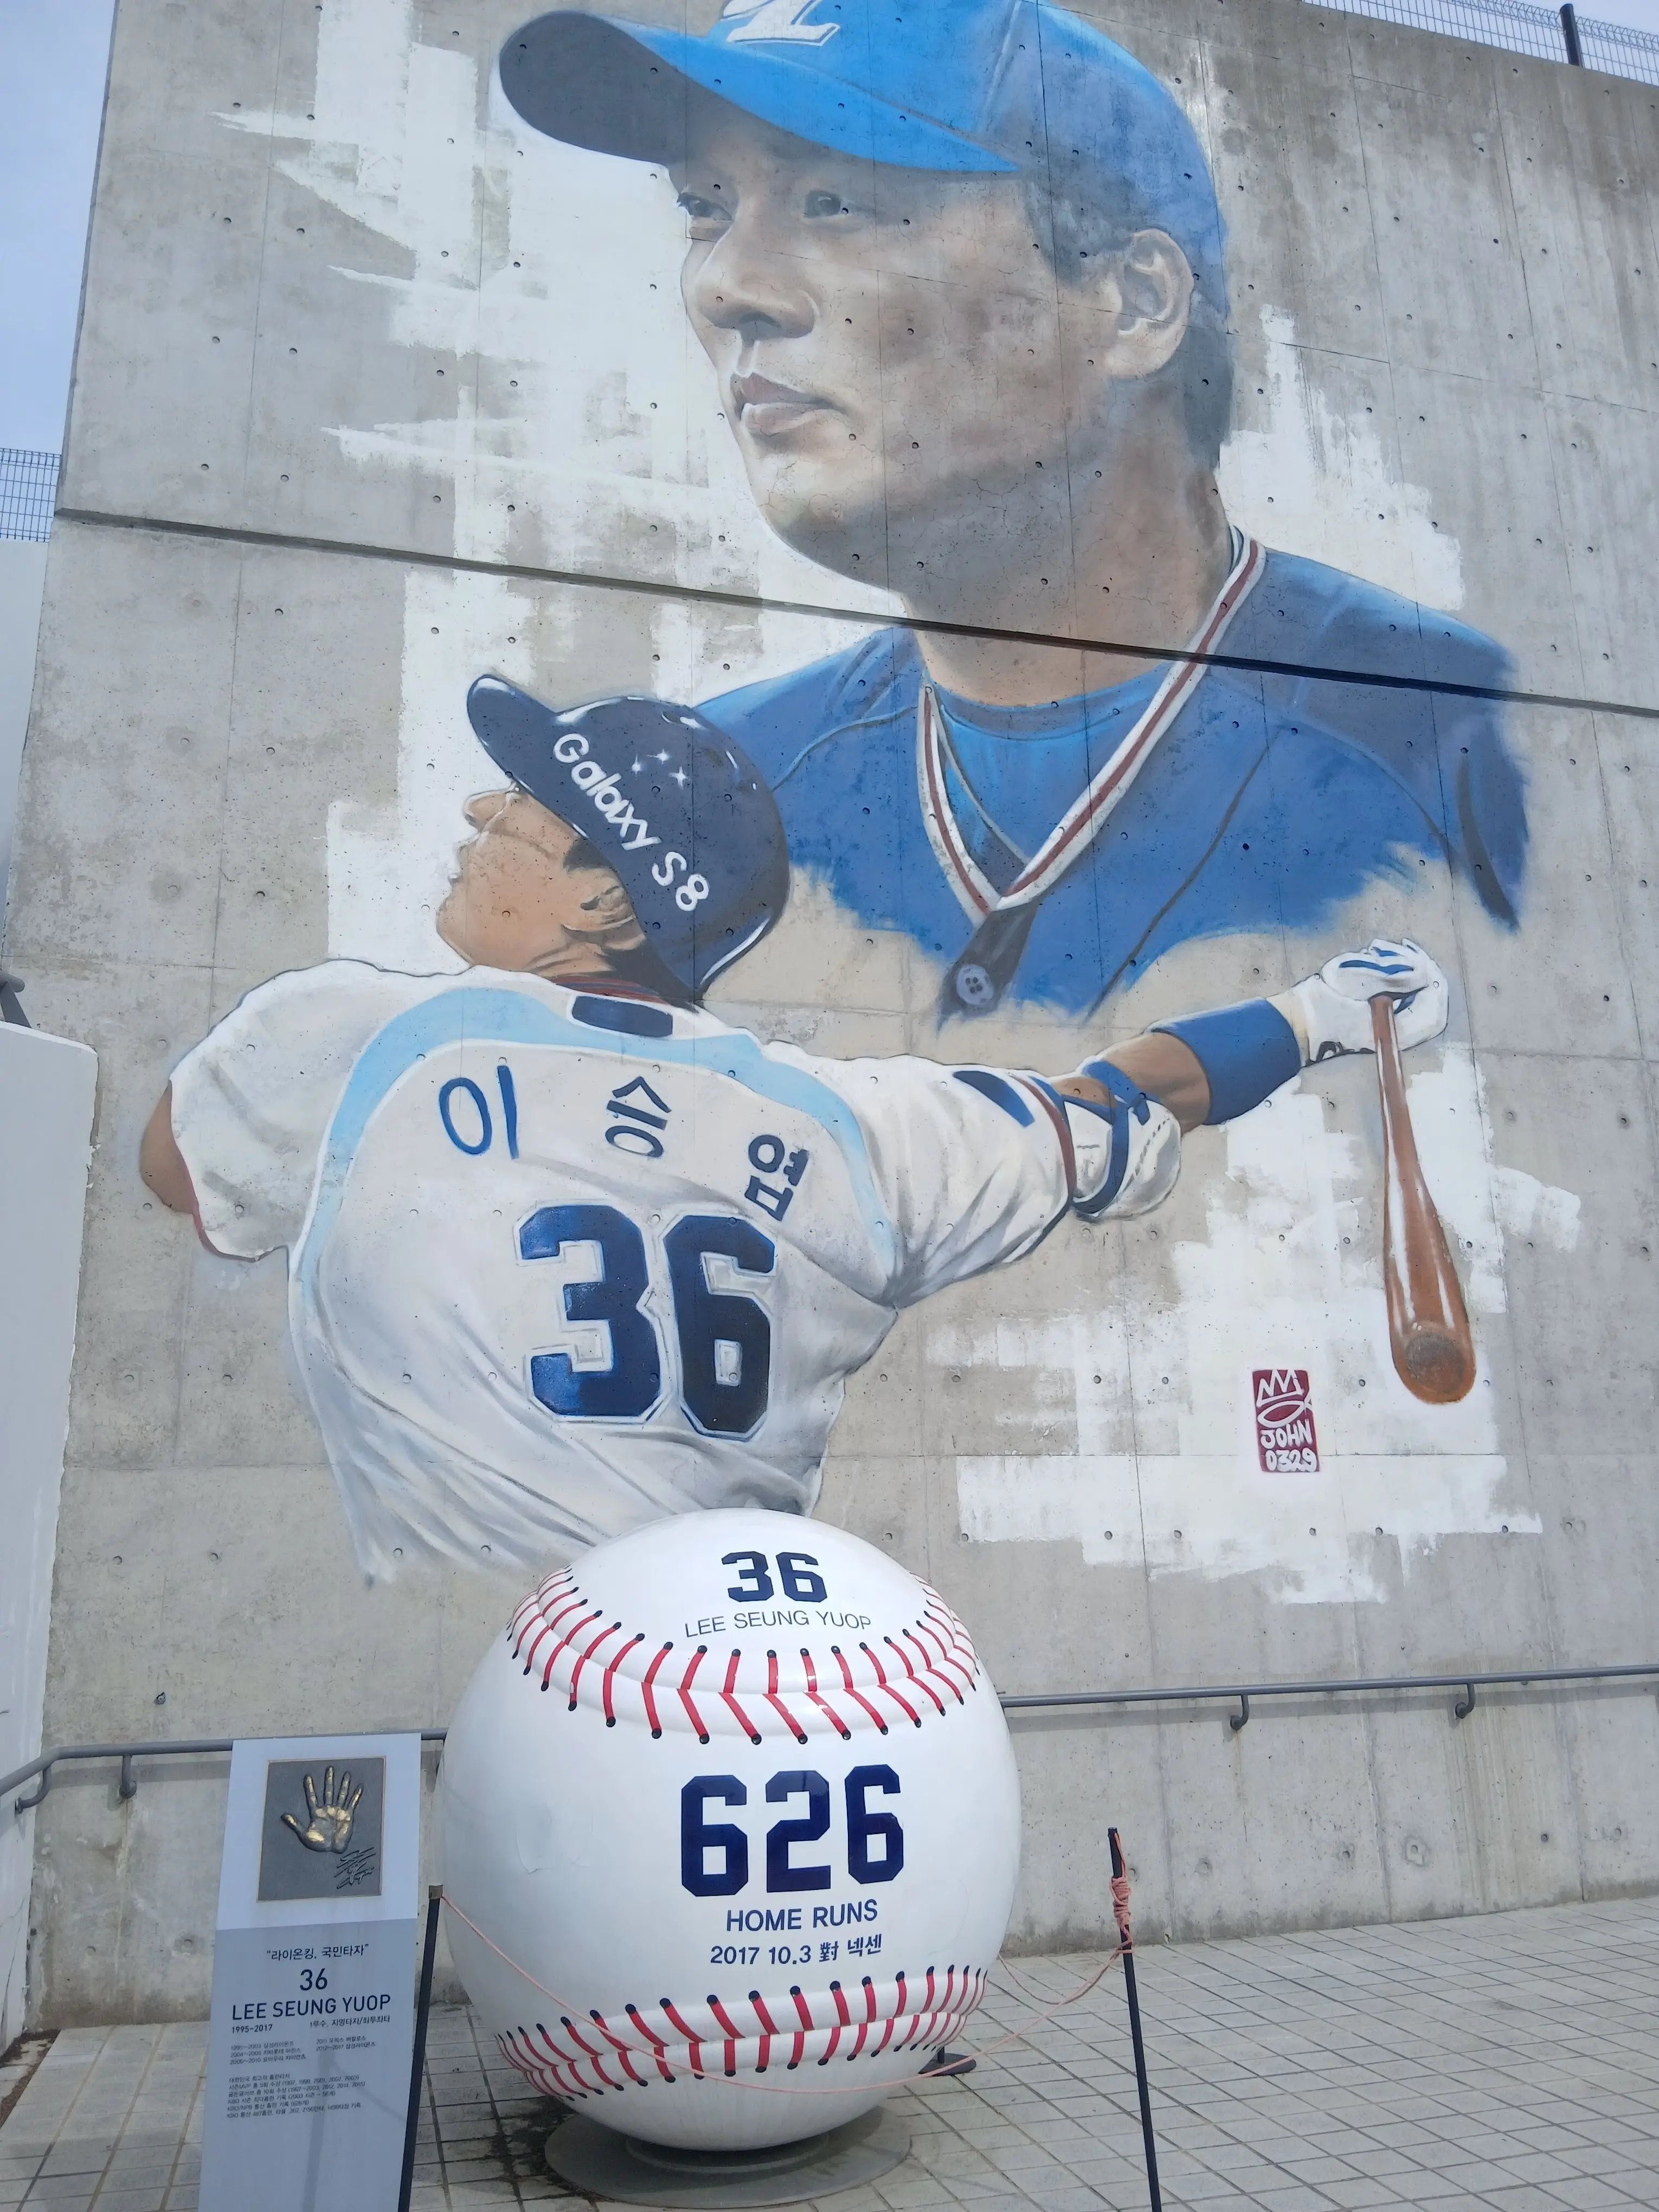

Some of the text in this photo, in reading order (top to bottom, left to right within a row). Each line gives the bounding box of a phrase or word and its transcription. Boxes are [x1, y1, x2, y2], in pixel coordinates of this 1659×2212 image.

[554, 733, 709, 911] Galaxy S8
[518, 1204, 775, 1436] 36
[1260, 1418, 1313, 1449] JOHN
[1265, 1447, 1317, 1472] 0329
[721, 1551, 827, 1603] 36
[685, 1610, 871, 1637] LEE SEUNG YUOP
[681, 1764, 904, 1896] 626
[726, 1899, 878, 1931] HOME RUNS
[711, 1946, 760, 1964] 2017
[769, 1945, 811, 1964] 10.3
[847, 1933, 882, 1957] 넥센
[300, 1967, 327, 1991] 36
[232, 1994, 390, 2020] LEE SEUNG YUOP
